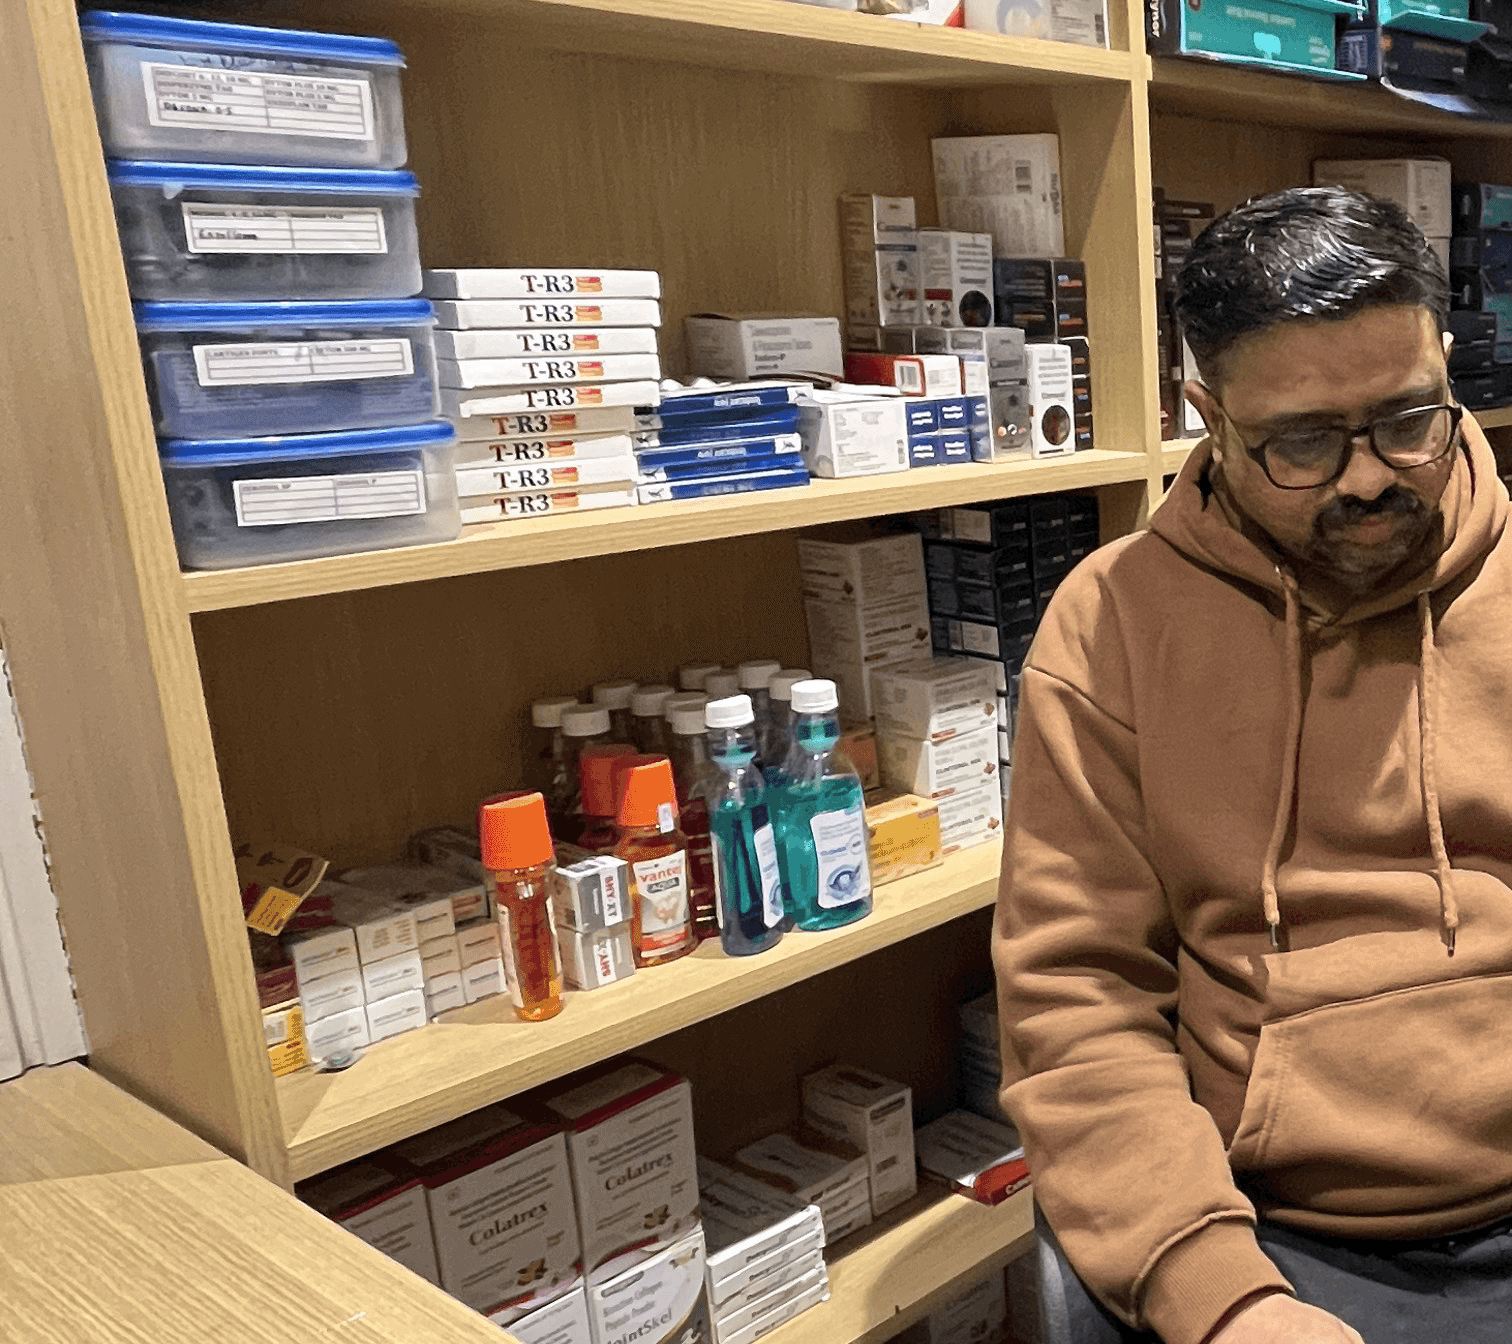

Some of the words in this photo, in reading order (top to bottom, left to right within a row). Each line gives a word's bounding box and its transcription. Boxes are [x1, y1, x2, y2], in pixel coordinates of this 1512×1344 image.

[520, 275, 574, 293] T-R3
[519, 305, 574, 323] T-R3
[517, 334, 571, 352] T-R3
[522, 361, 576, 379] T-R3
[521, 389, 575, 408] T-R3
[491, 414, 548, 436] T-R3
[489, 441, 545, 462] T-R3
[494, 468, 550, 489] T-R3
[494, 494, 550, 516] T-R3
[605, 1153, 674, 1191] Colatrex
[469, 1201, 549, 1246] Colatrex
